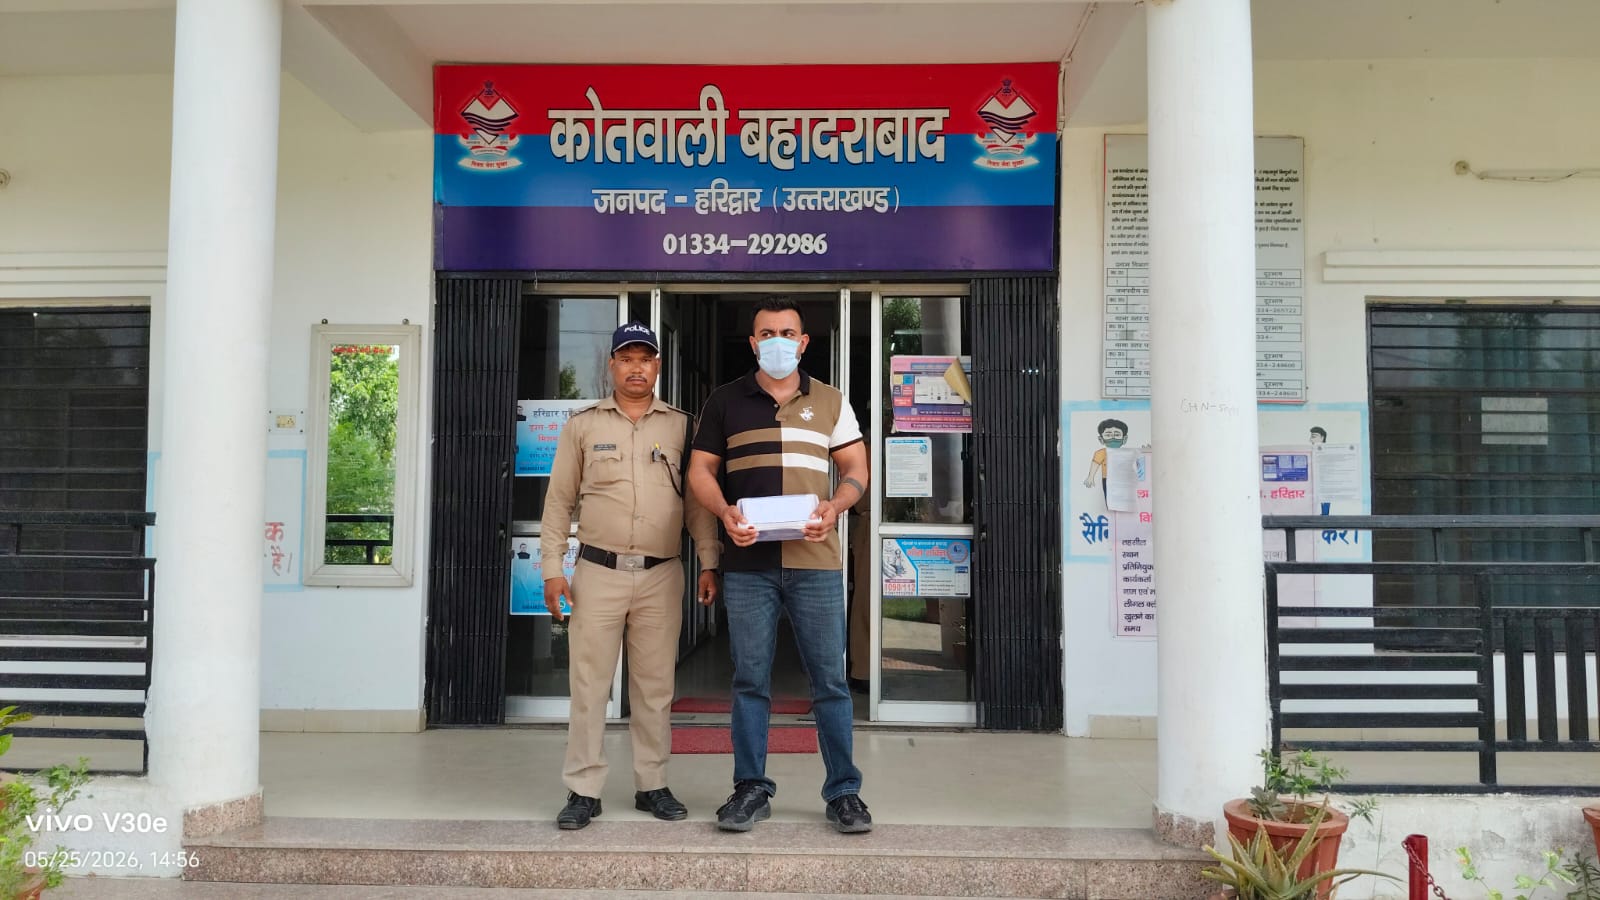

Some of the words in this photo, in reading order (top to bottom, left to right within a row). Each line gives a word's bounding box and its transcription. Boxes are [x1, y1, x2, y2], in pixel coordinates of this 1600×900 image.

[548, 84, 730, 168] कोतवाली
[738, 107, 950, 171] बहादराबाद
[591, 188, 668, 215] जनपद
[694, 177, 763, 216] हरिद्वार
[662, 232, 829, 256] 01334-292986
[1270, 487, 1306, 499] हरिद्वार
[1122, 537, 1147, 546] तहसील
[1122, 551, 1140, 559] स्थान
[1124, 625, 1141, 633] समय
